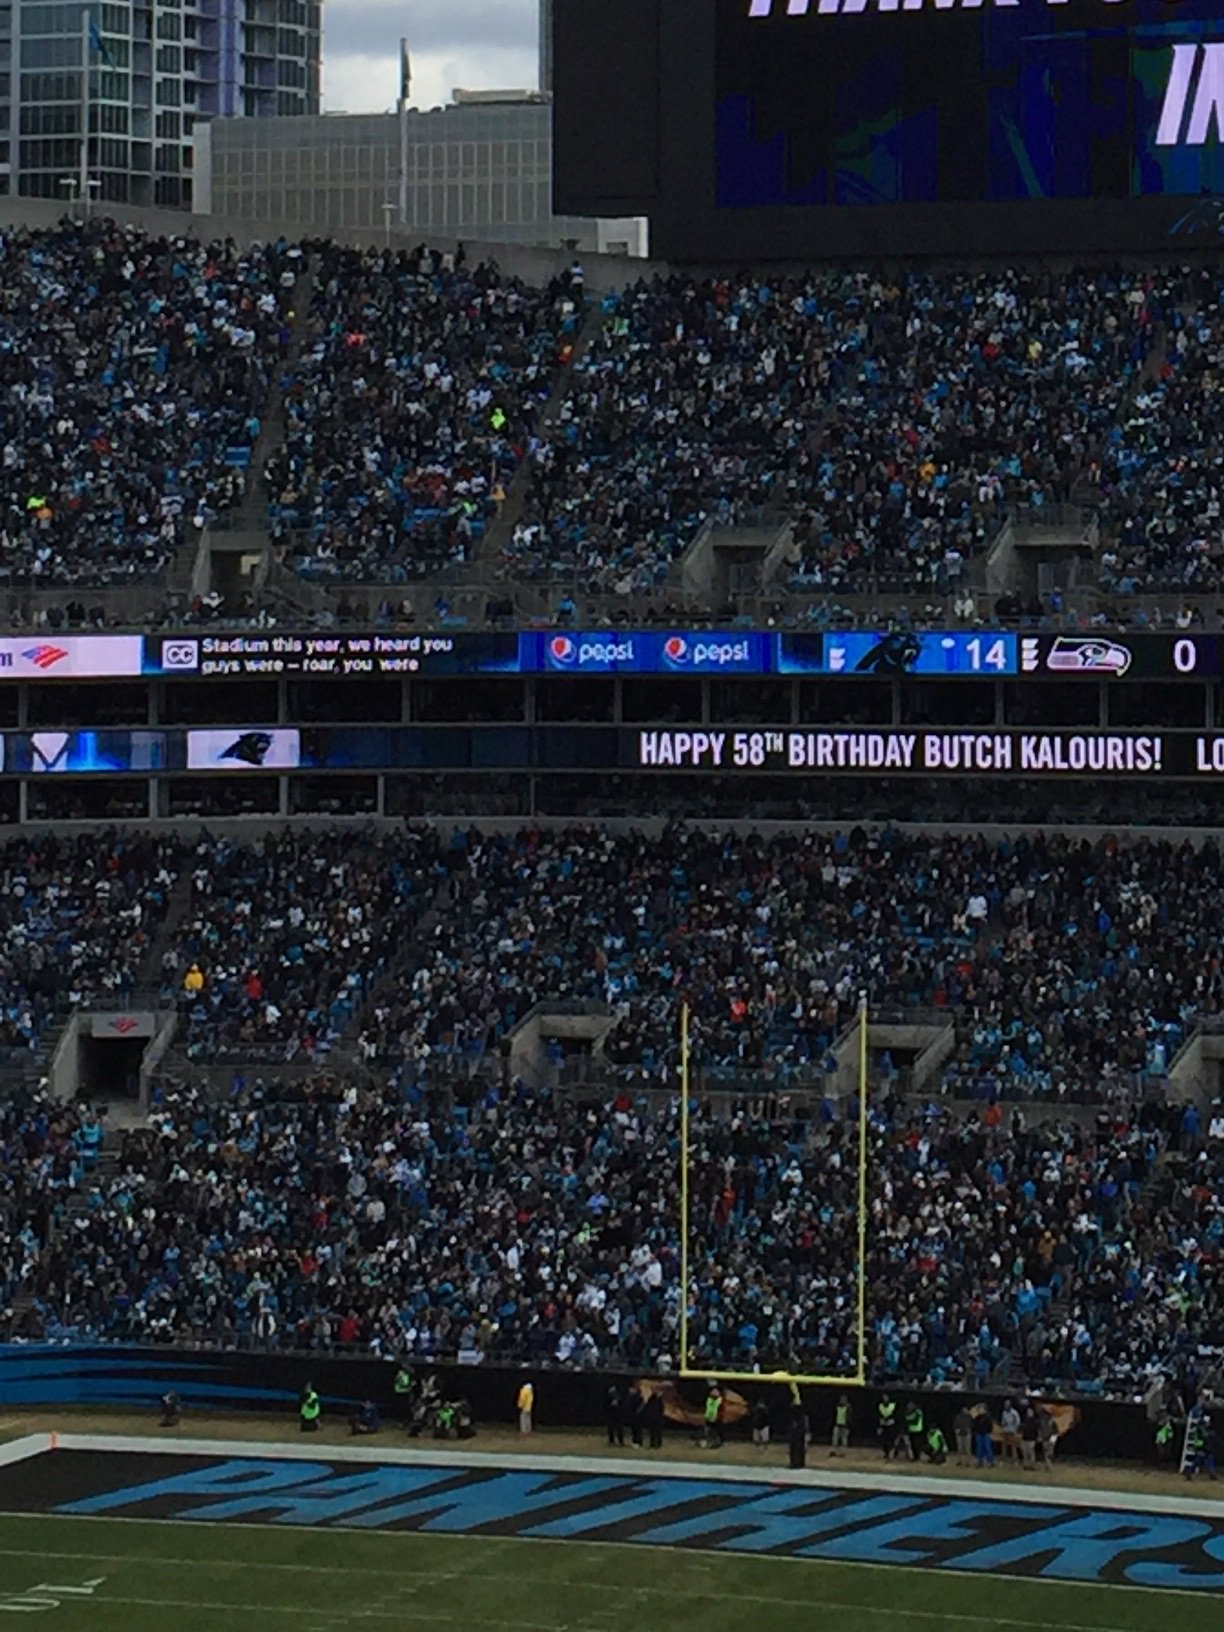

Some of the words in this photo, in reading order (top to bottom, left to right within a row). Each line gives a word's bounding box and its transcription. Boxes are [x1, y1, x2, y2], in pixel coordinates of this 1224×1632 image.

[167, 645, 194, 665] CC
[202, 637, 269, 653] Stadium
[272, 637, 302, 653] this
[349, 639, 371, 652] we
[374, 636, 420, 651] heard
[423, 639, 453, 654] you
[578, 640, 634, 664] pepsi
[694, 640, 749, 664] pepsi
[966, 639, 1006, 670] 14
[1174, 640, 1196, 672] 0
[202, 659, 240, 676] guys
[302, 659, 340, 673] roar,
[343, 659, 373, 673] you
[640, 732, 726, 765] HAPPY
[788, 733, 916, 767] BIRTHDAY
[924, 734, 1012, 769] BUTCH
[1021, 735, 1162, 771] KALOURIS!
